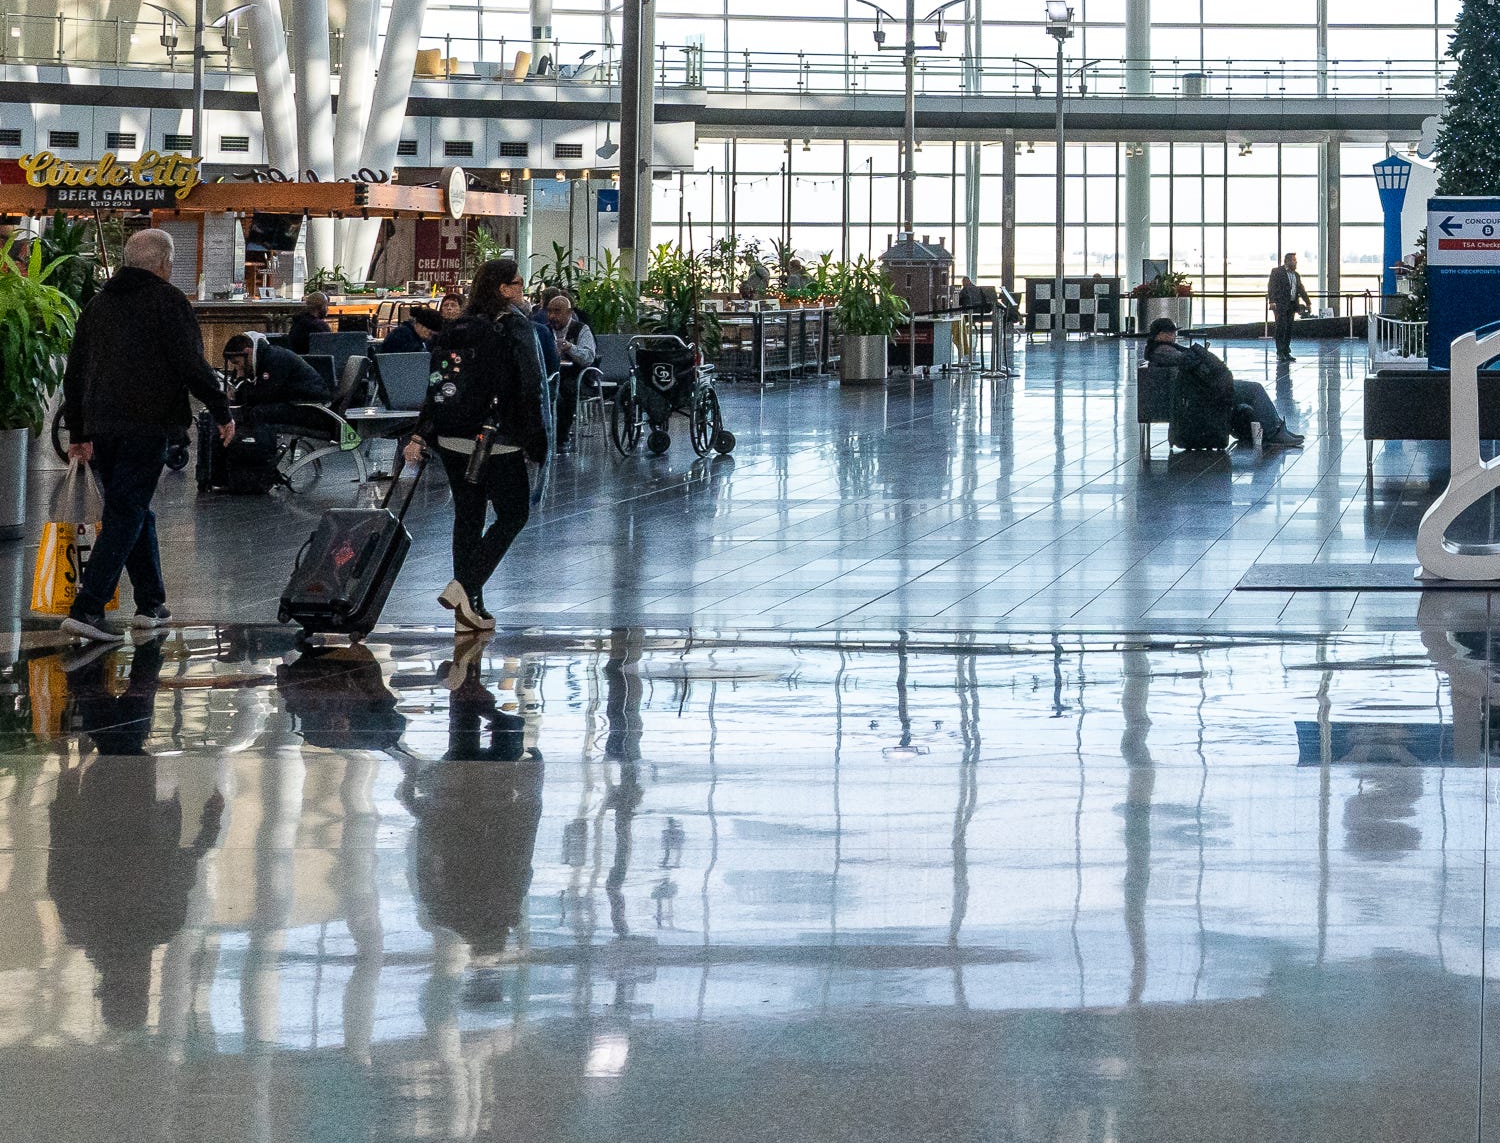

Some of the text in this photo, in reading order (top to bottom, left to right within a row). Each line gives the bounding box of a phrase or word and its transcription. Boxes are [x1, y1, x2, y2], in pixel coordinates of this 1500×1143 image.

[18, 150, 204, 200] Circle City
[58, 189, 165, 201] BEER GARDEN
[417, 258, 460, 269] CREATING
